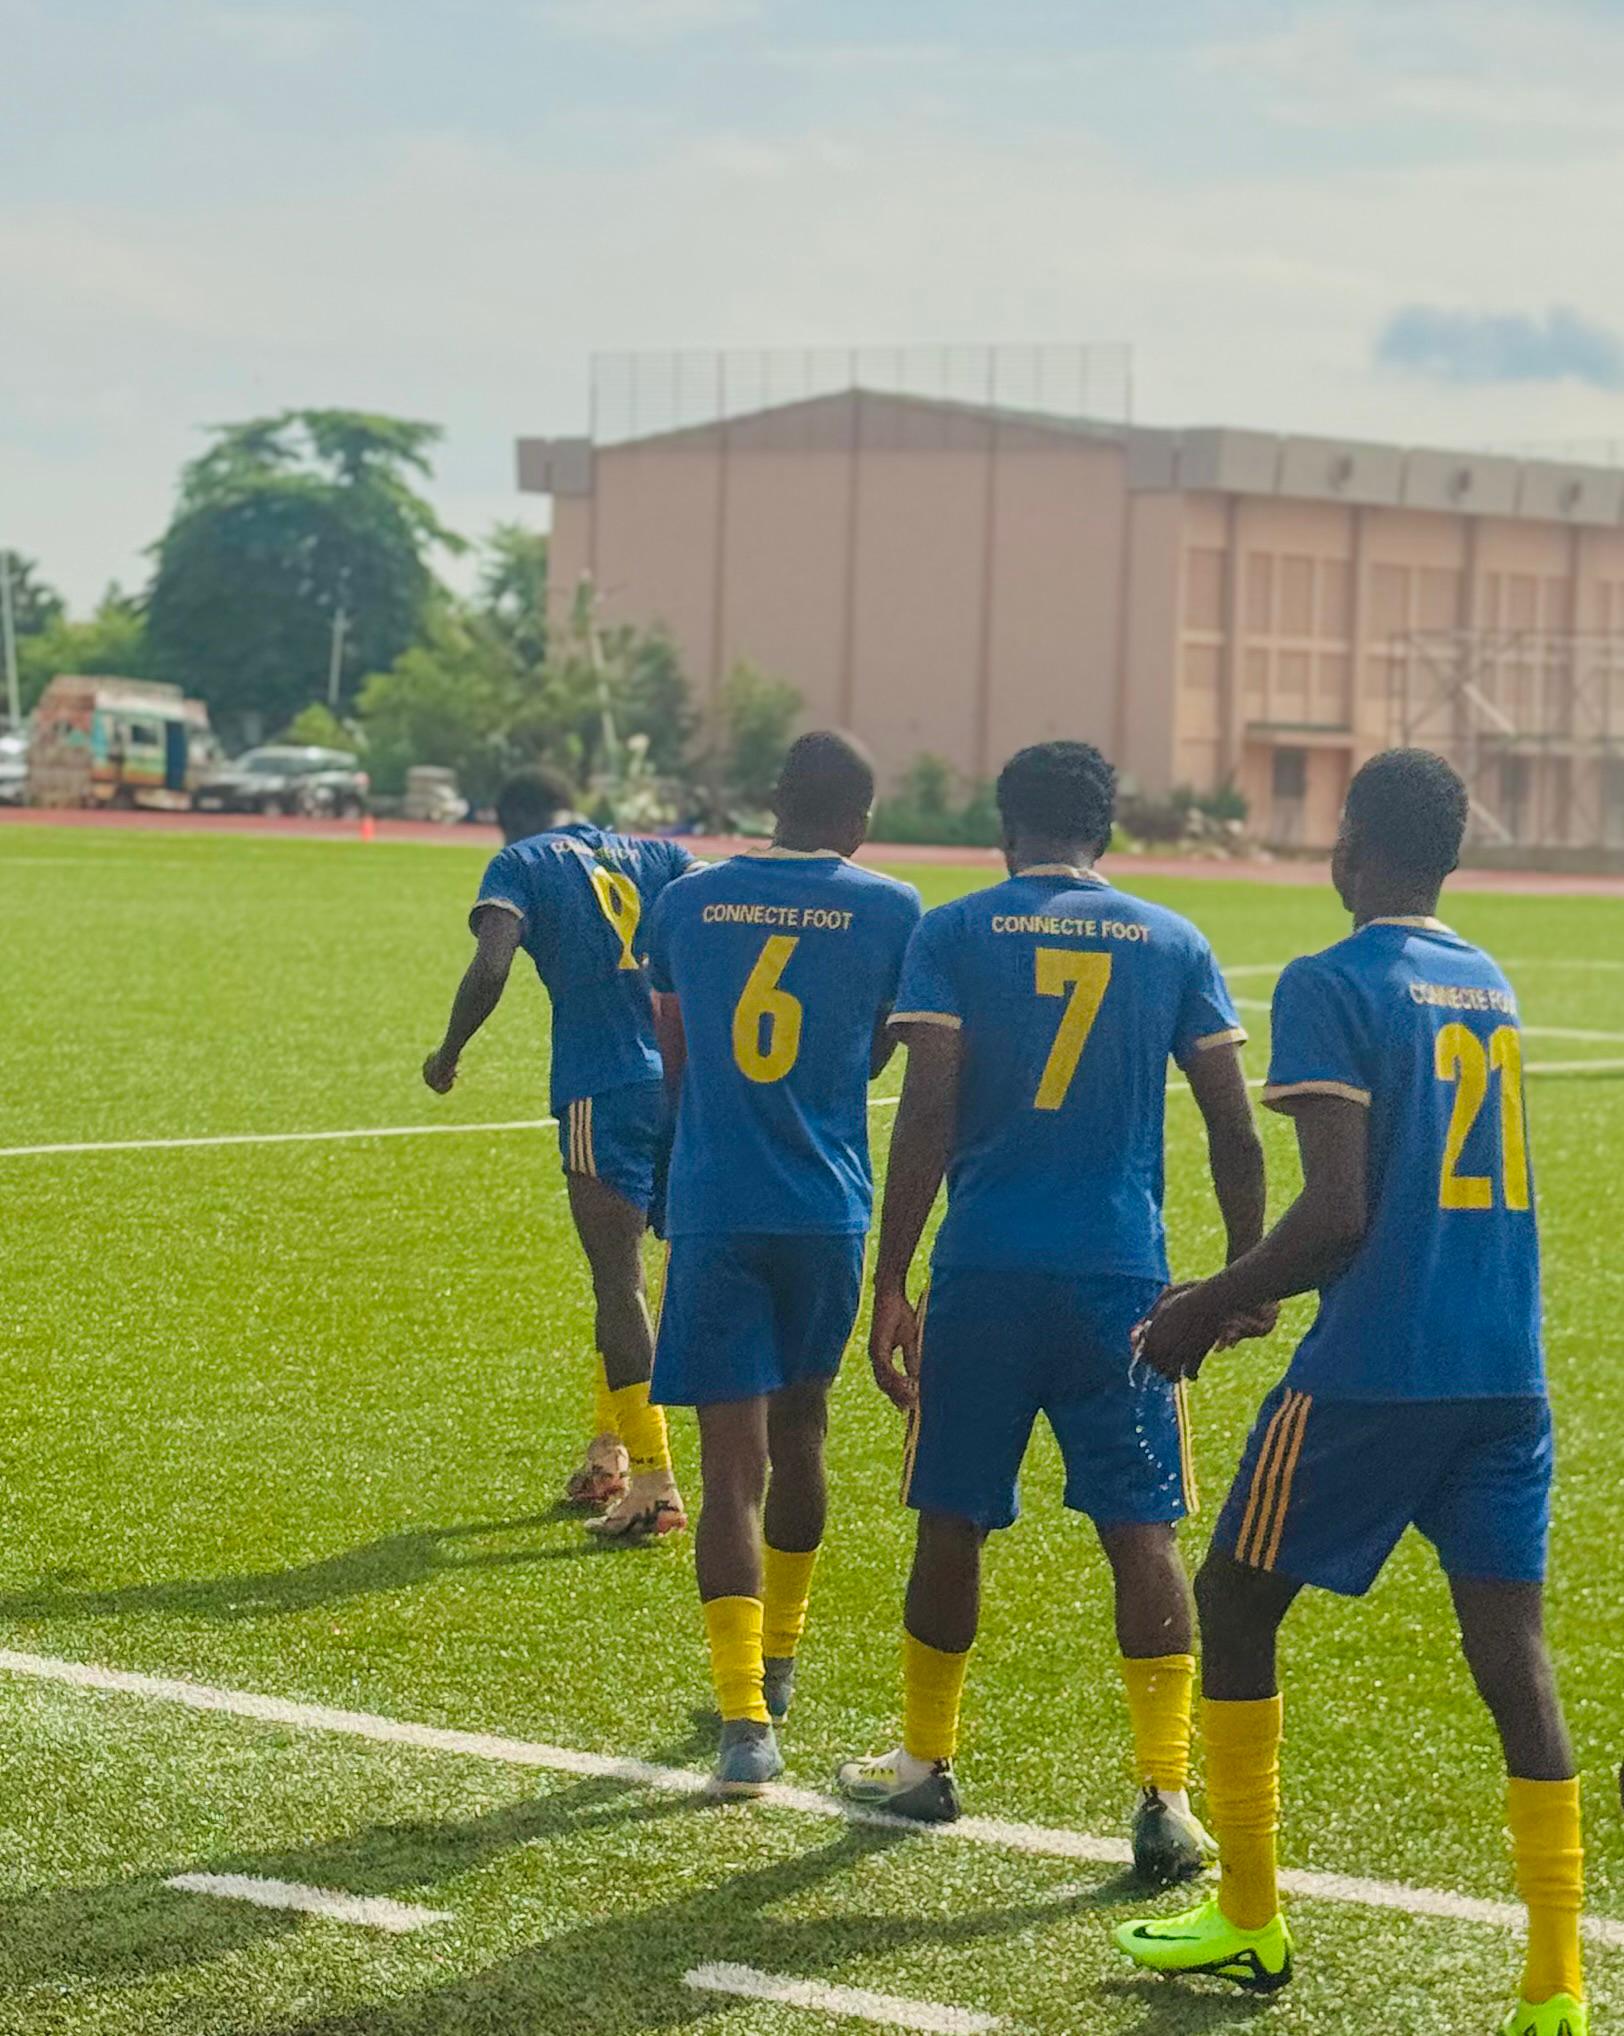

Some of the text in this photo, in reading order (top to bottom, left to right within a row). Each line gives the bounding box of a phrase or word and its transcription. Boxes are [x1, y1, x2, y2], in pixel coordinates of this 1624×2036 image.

[703, 904, 852, 930] CONNECTE FOOT
[992, 916, 1151, 942] CONNECTE FOOT
[733, 934, 803, 1083] 6
[1034, 947, 1112, 1110] 7
[1434, 1022, 1529, 1211] 21
